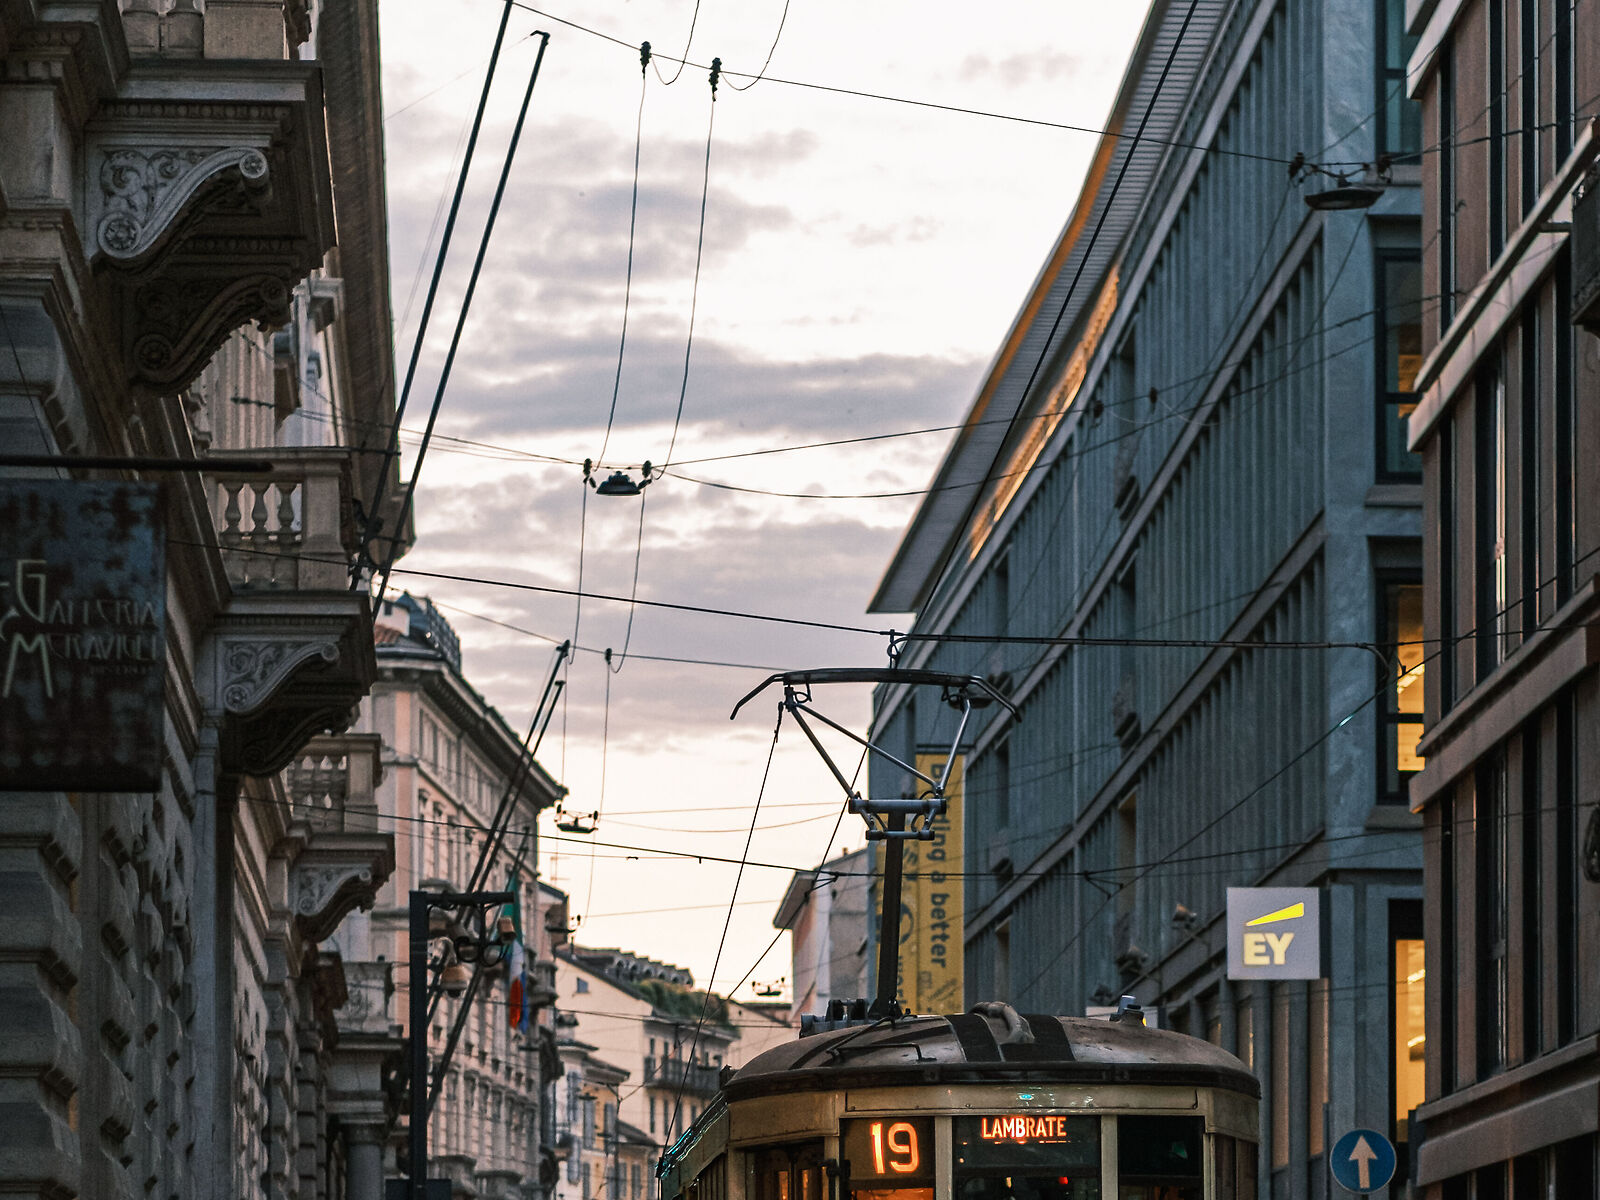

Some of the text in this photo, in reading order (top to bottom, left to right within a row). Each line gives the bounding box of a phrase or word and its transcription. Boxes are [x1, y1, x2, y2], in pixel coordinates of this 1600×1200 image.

[931, 893, 950, 969] better
[1243, 931, 1295, 965] EY
[870, 1122, 919, 1174] 19
[981, 1116, 1067, 1139] LAMBRATE
